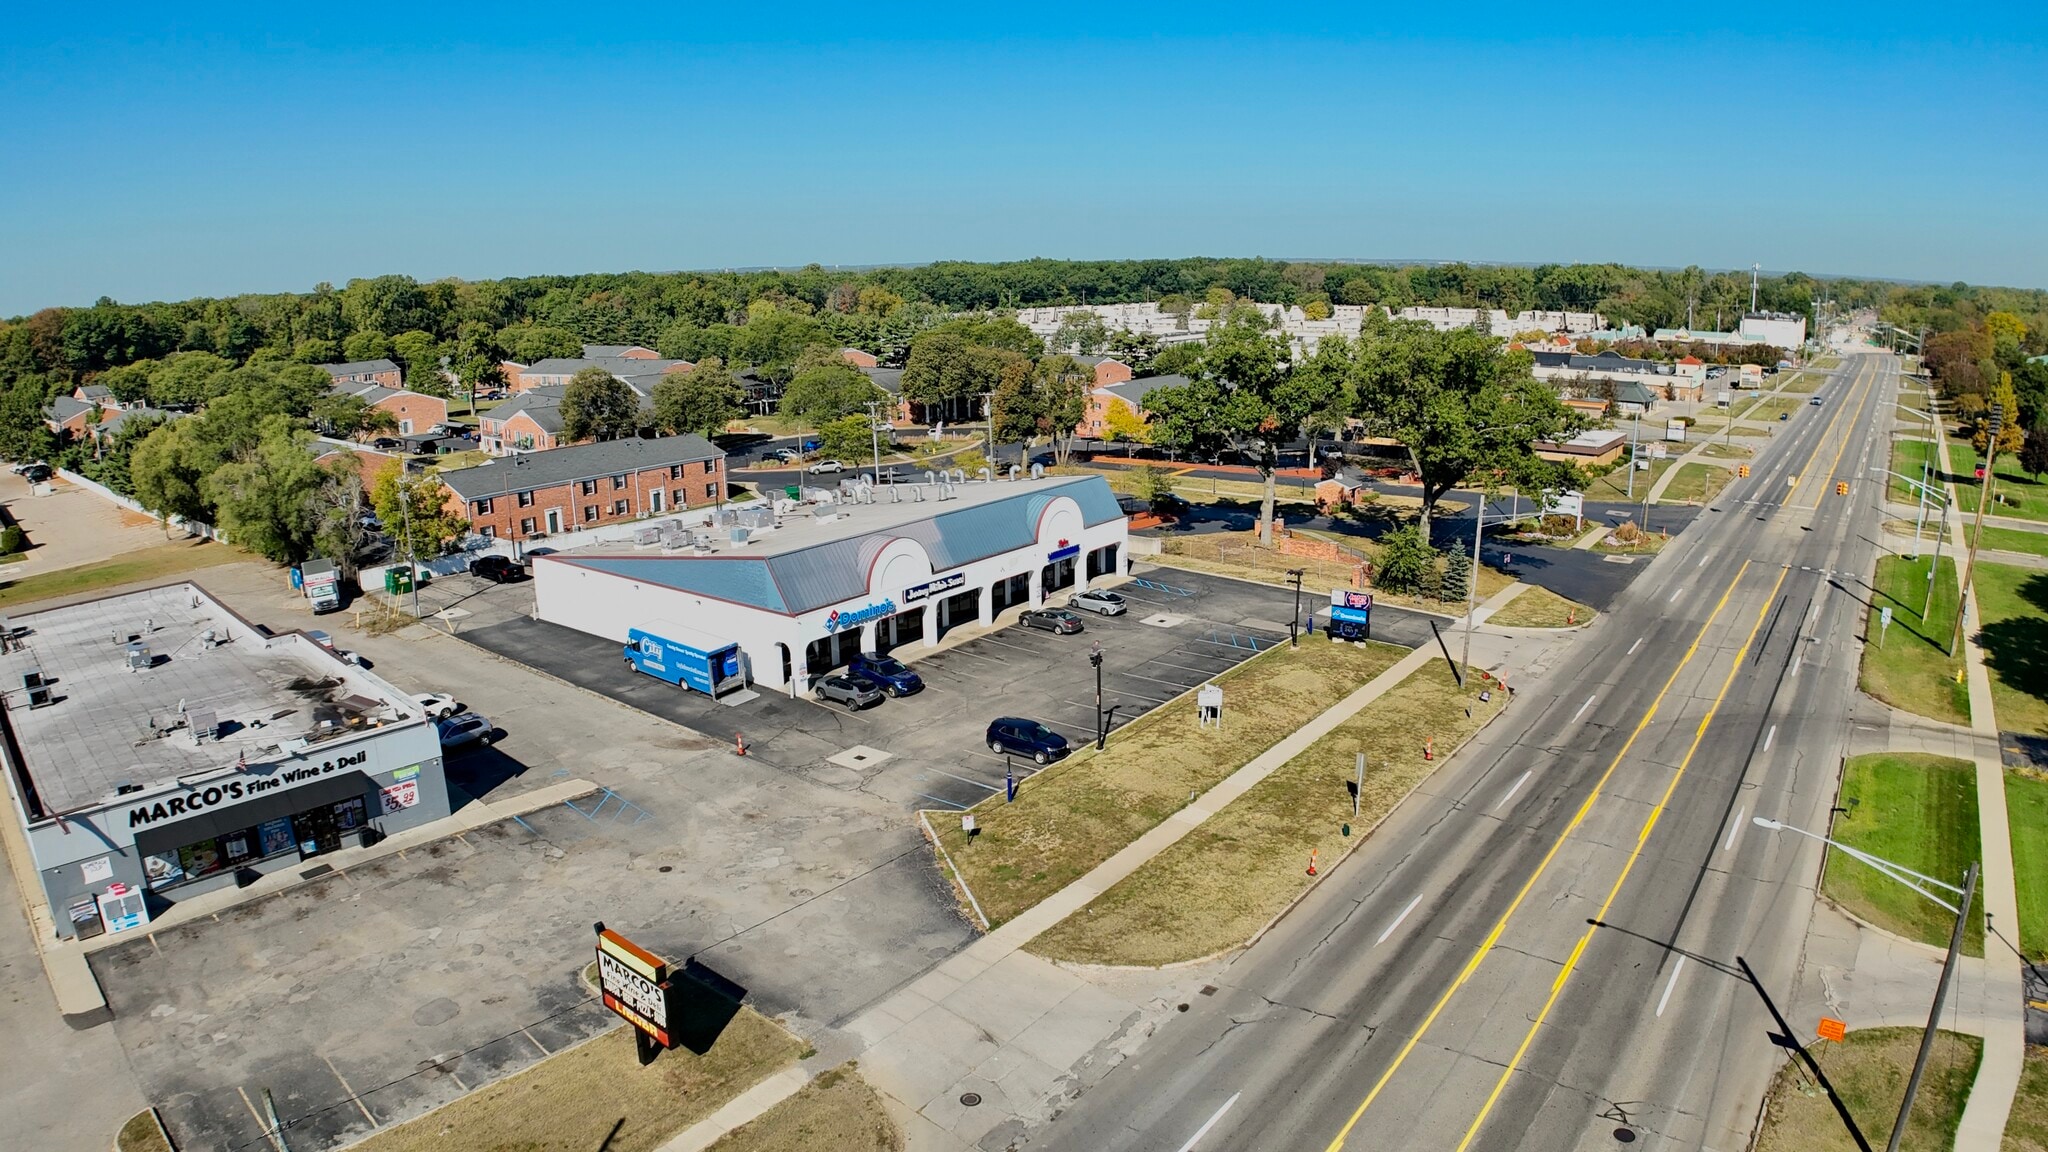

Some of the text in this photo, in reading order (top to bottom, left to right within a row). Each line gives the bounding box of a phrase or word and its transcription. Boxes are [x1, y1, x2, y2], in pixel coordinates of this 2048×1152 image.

[839, 598, 896, 626] Domino's
[129, 781, 244, 828] MARCO'S
[246, 777, 280, 795] Fine
[281, 767, 320, 784] Wine
[322, 761, 335, 774] &
[336, 750, 367, 769] Deli
[603, 955, 661, 1002] MARCO'S
